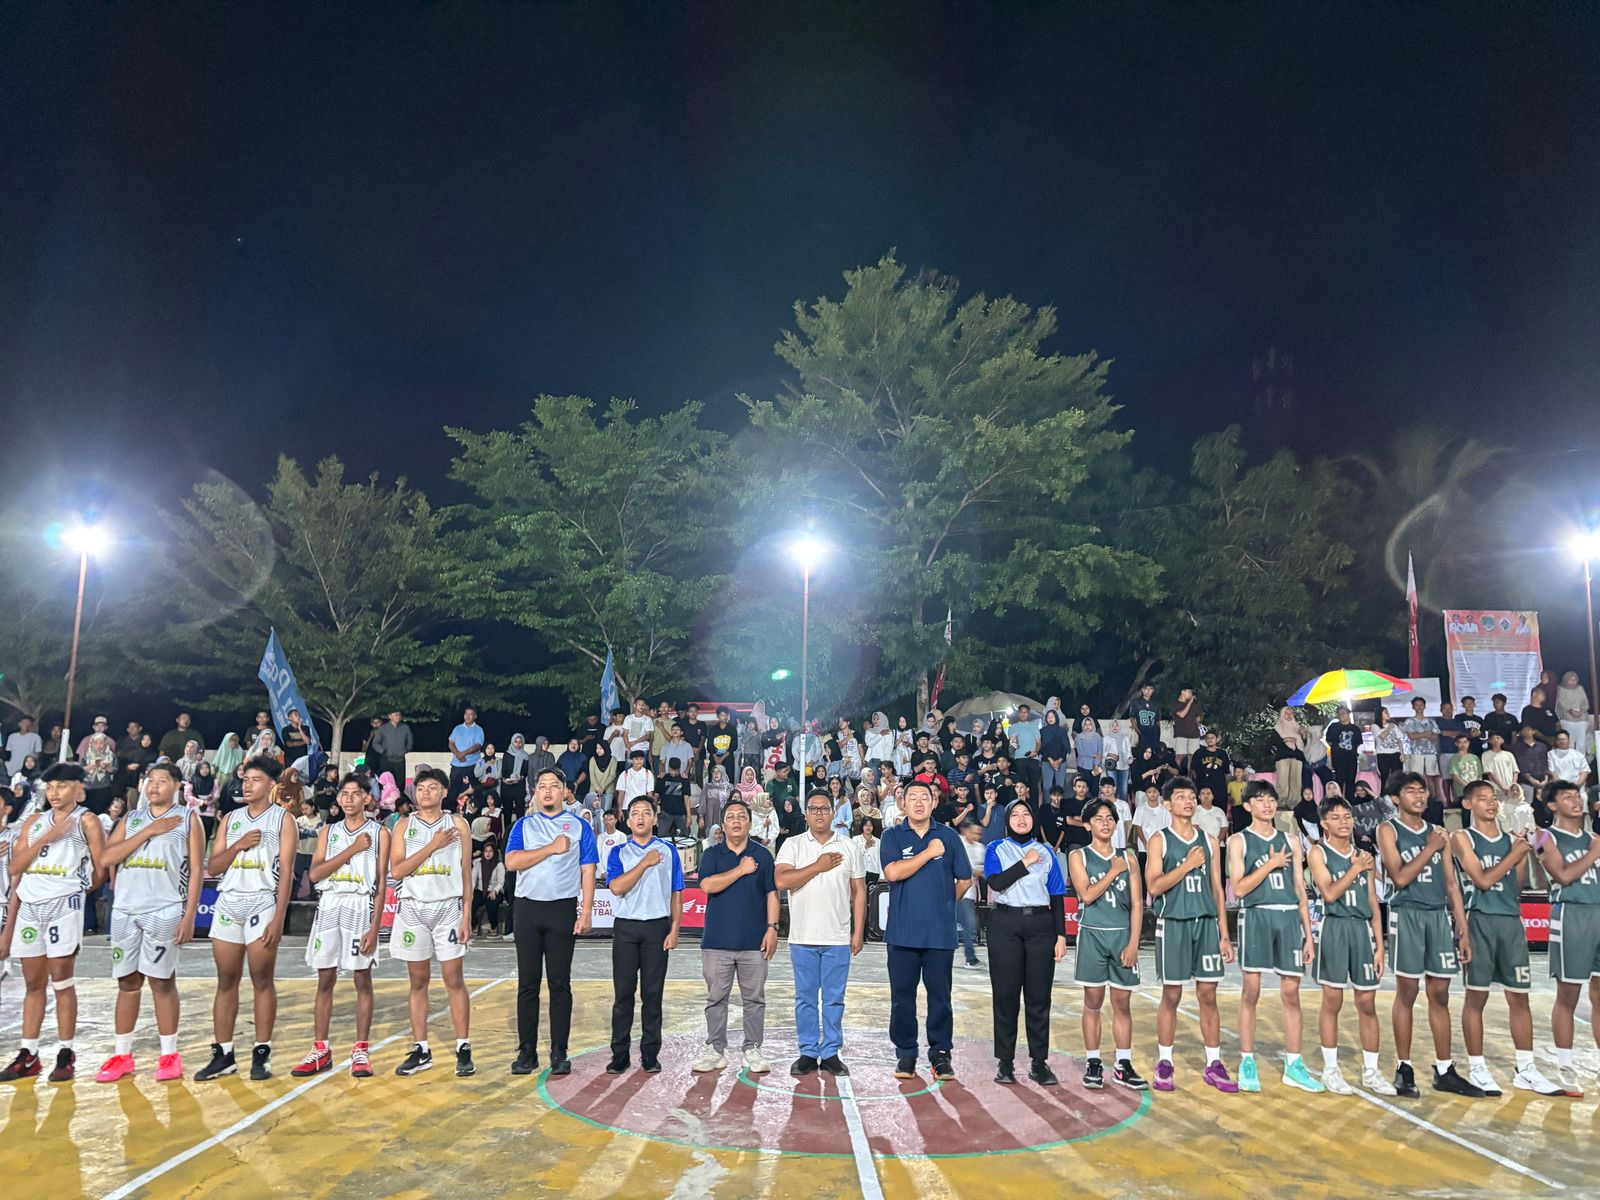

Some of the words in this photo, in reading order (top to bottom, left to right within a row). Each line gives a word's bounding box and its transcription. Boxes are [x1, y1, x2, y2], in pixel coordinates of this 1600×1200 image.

[1138, 709, 1156, 727] 87
[664, 781, 684, 796] 72
[38, 845, 49, 858] 8
[1268, 872, 1285, 890] 10
[1416, 865, 1433, 883] 12
[1185, 875, 1202, 892] 07
[1105, 890, 1117, 908] 4
[1345, 889, 1357, 907] 11
[1523, 918, 1550, 928] HON
[48, 925, 60, 945] 8
[448, 928, 458, 945] 4
[153, 945, 167, 964] 7
[351, 939, 361, 956] 5
[1202, 953, 1221, 972] 07
[1439, 952, 1457, 969] 12
[1514, 966, 1531, 983] 15
